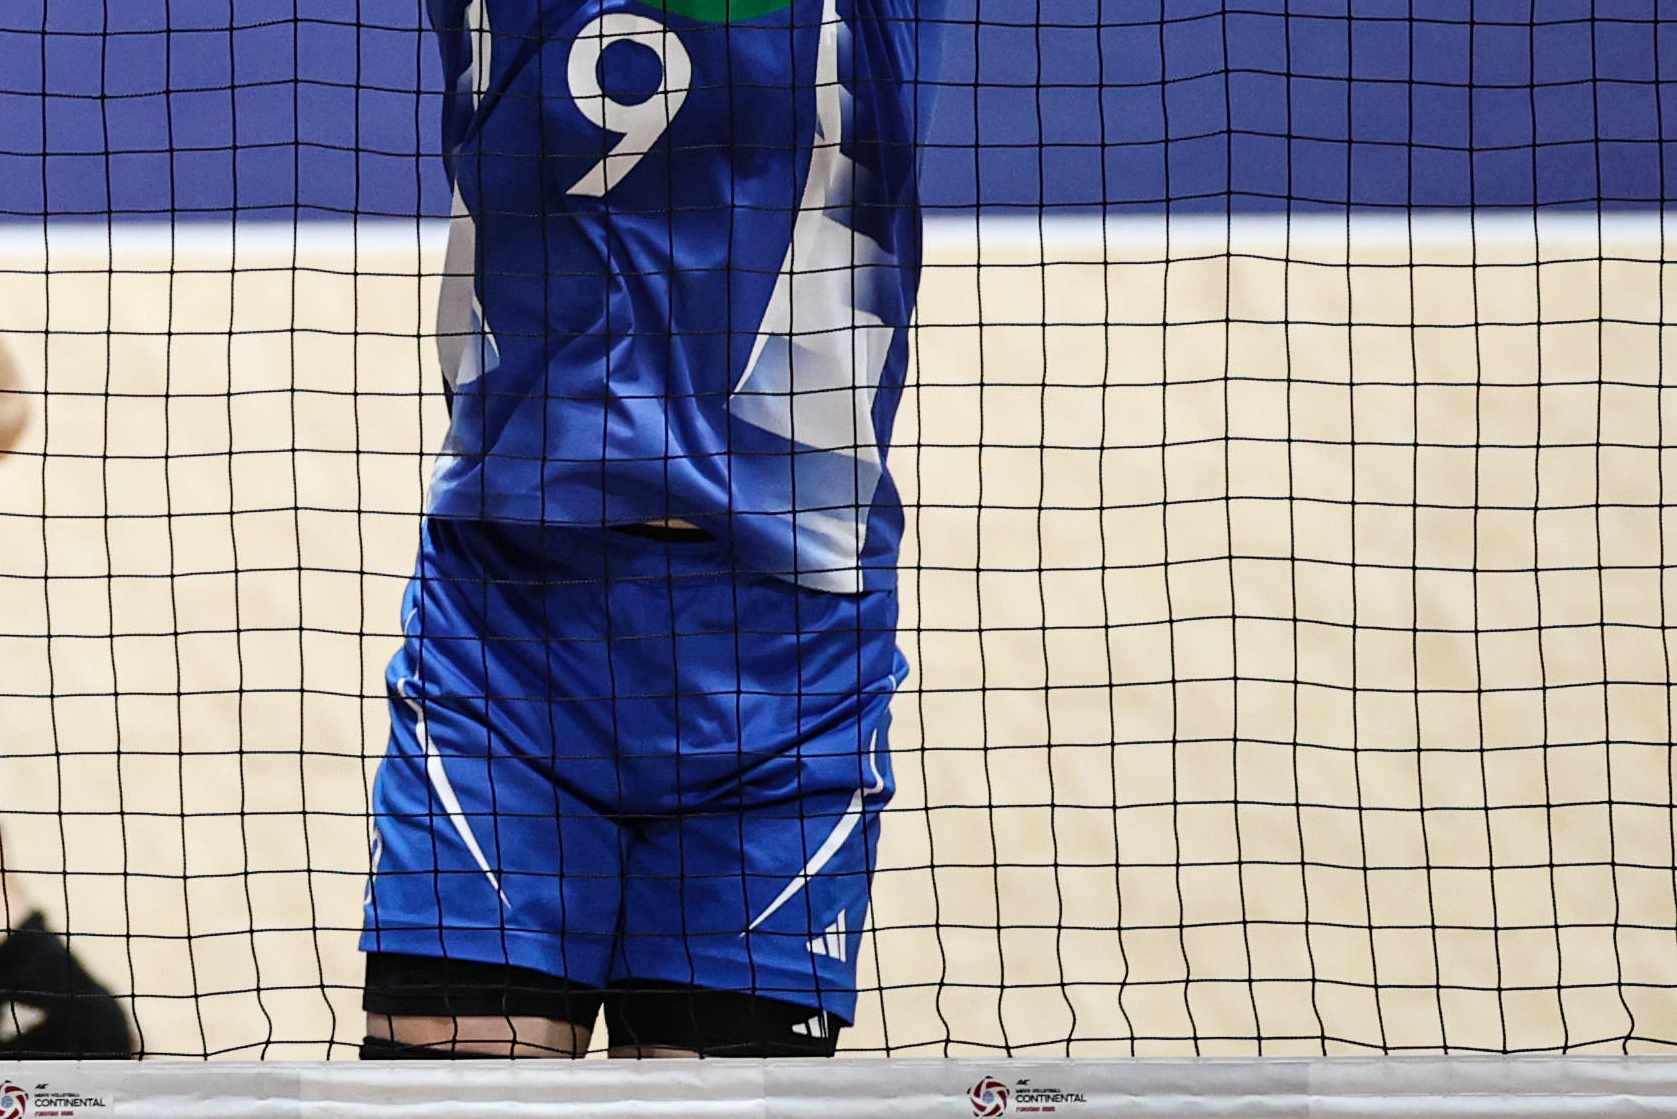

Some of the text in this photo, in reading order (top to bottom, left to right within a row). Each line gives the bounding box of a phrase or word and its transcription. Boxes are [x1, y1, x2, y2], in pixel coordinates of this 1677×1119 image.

[565, 12, 693, 198] 9
[35, 1098, 106, 1107] CONTINENTAL
[1016, 1094, 1087, 1103] CONTINENTAL
